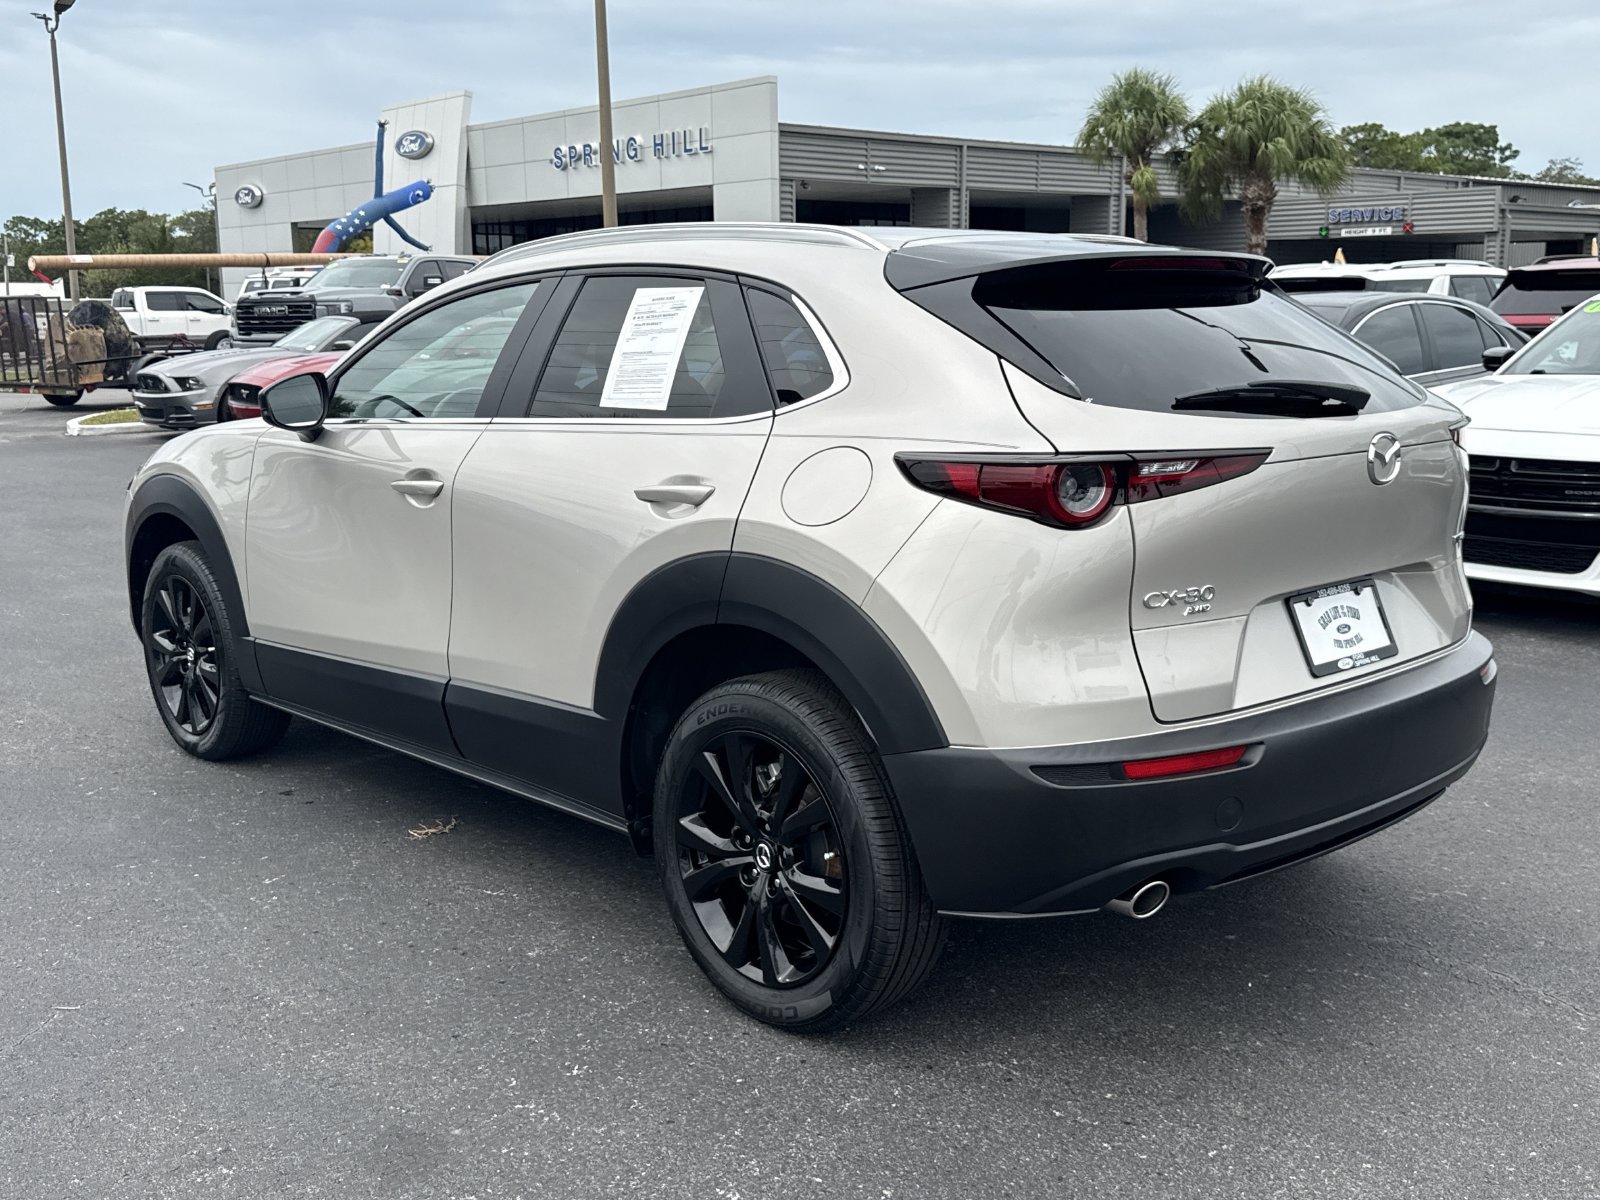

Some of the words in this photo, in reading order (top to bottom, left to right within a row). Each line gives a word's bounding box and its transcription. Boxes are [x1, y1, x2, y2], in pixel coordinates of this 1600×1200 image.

[400, 135, 420, 153] Ford
[554, 137, 638, 169] SPRNG
[653, 128, 709, 157] HILL
[1328, 208, 1403, 223] SERVICE
[1143, 584, 1216, 609] CX-30
[1183, 604, 1211, 616] AWD
